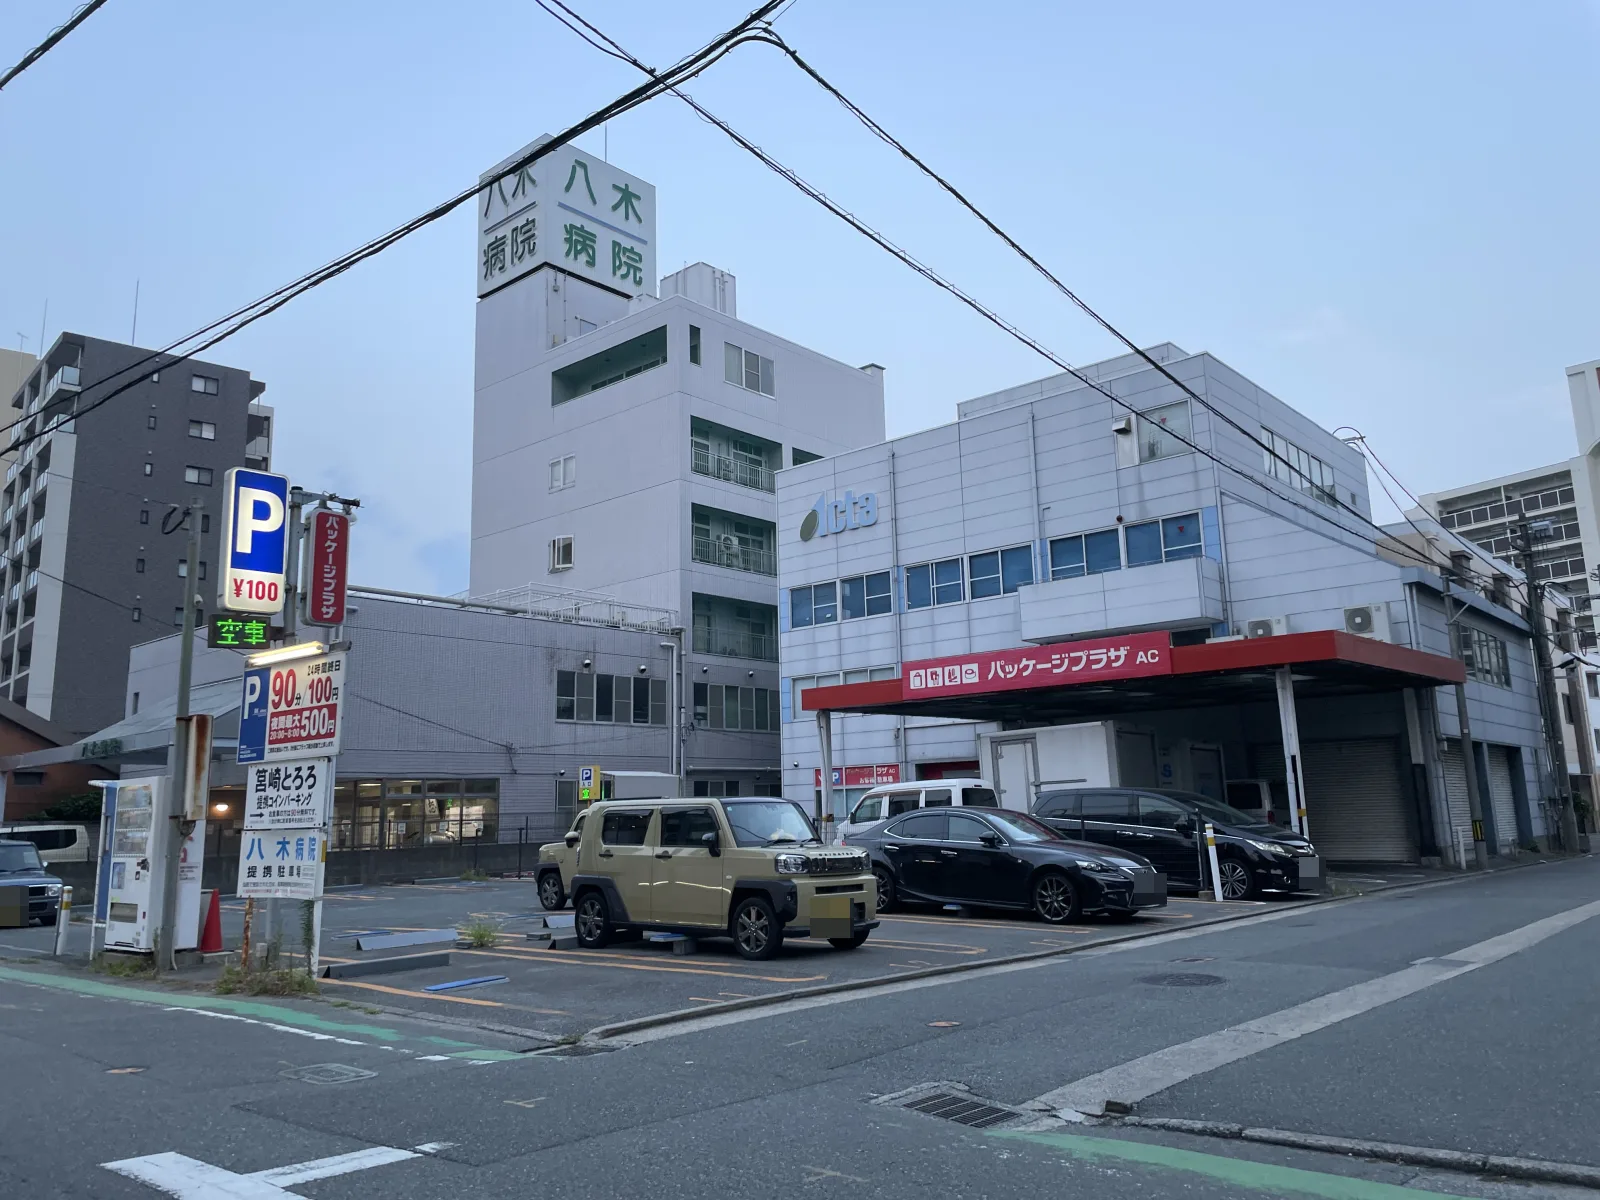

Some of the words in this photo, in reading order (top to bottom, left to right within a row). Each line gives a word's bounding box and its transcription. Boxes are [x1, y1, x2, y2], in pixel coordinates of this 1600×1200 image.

[564, 158, 643, 224] 八木
[483, 217, 537, 281] 病院
[564, 222, 643, 286] 病院
[236, 486, 285, 554] P
[800, 488, 878, 542] Acta
[320, 515, 339, 619] パッケージプラザ
[233, 578, 278, 602] ¥100
[216, 618, 267, 645] 空車
[307, 659, 341, 677] 24時間終日
[987, 646, 1130, 681] パッケージプラザ
[1136, 649, 1160, 665] AC
[243, 675, 261, 720] P
[300, 707, 335, 738] 500円
[583, 769, 590, 780] P
[245, 836, 317, 862] 八木病院
